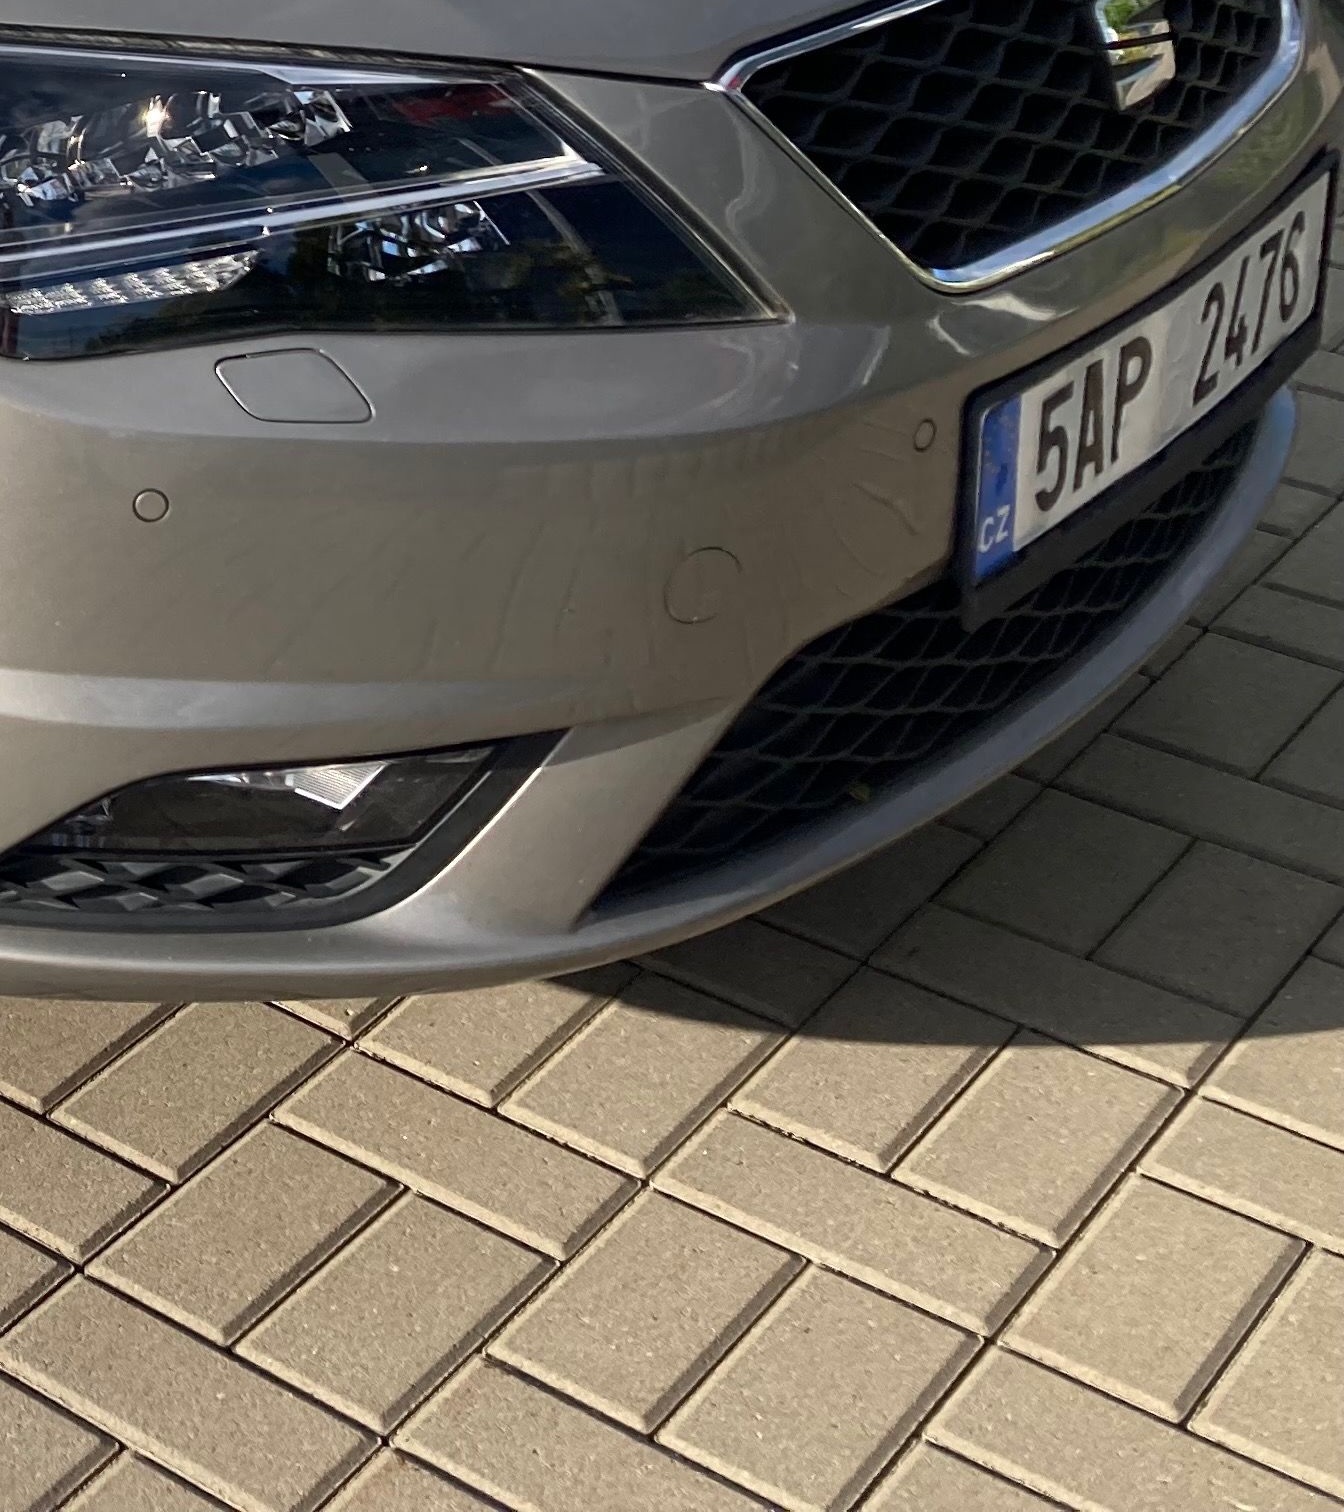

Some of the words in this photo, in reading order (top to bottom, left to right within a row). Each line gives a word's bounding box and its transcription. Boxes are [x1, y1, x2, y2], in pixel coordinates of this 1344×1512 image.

[1034, 335, 1153, 512] 5AP
[1192, 210, 1306, 408] 2476
[977, 504, 1010, 553] CZ
